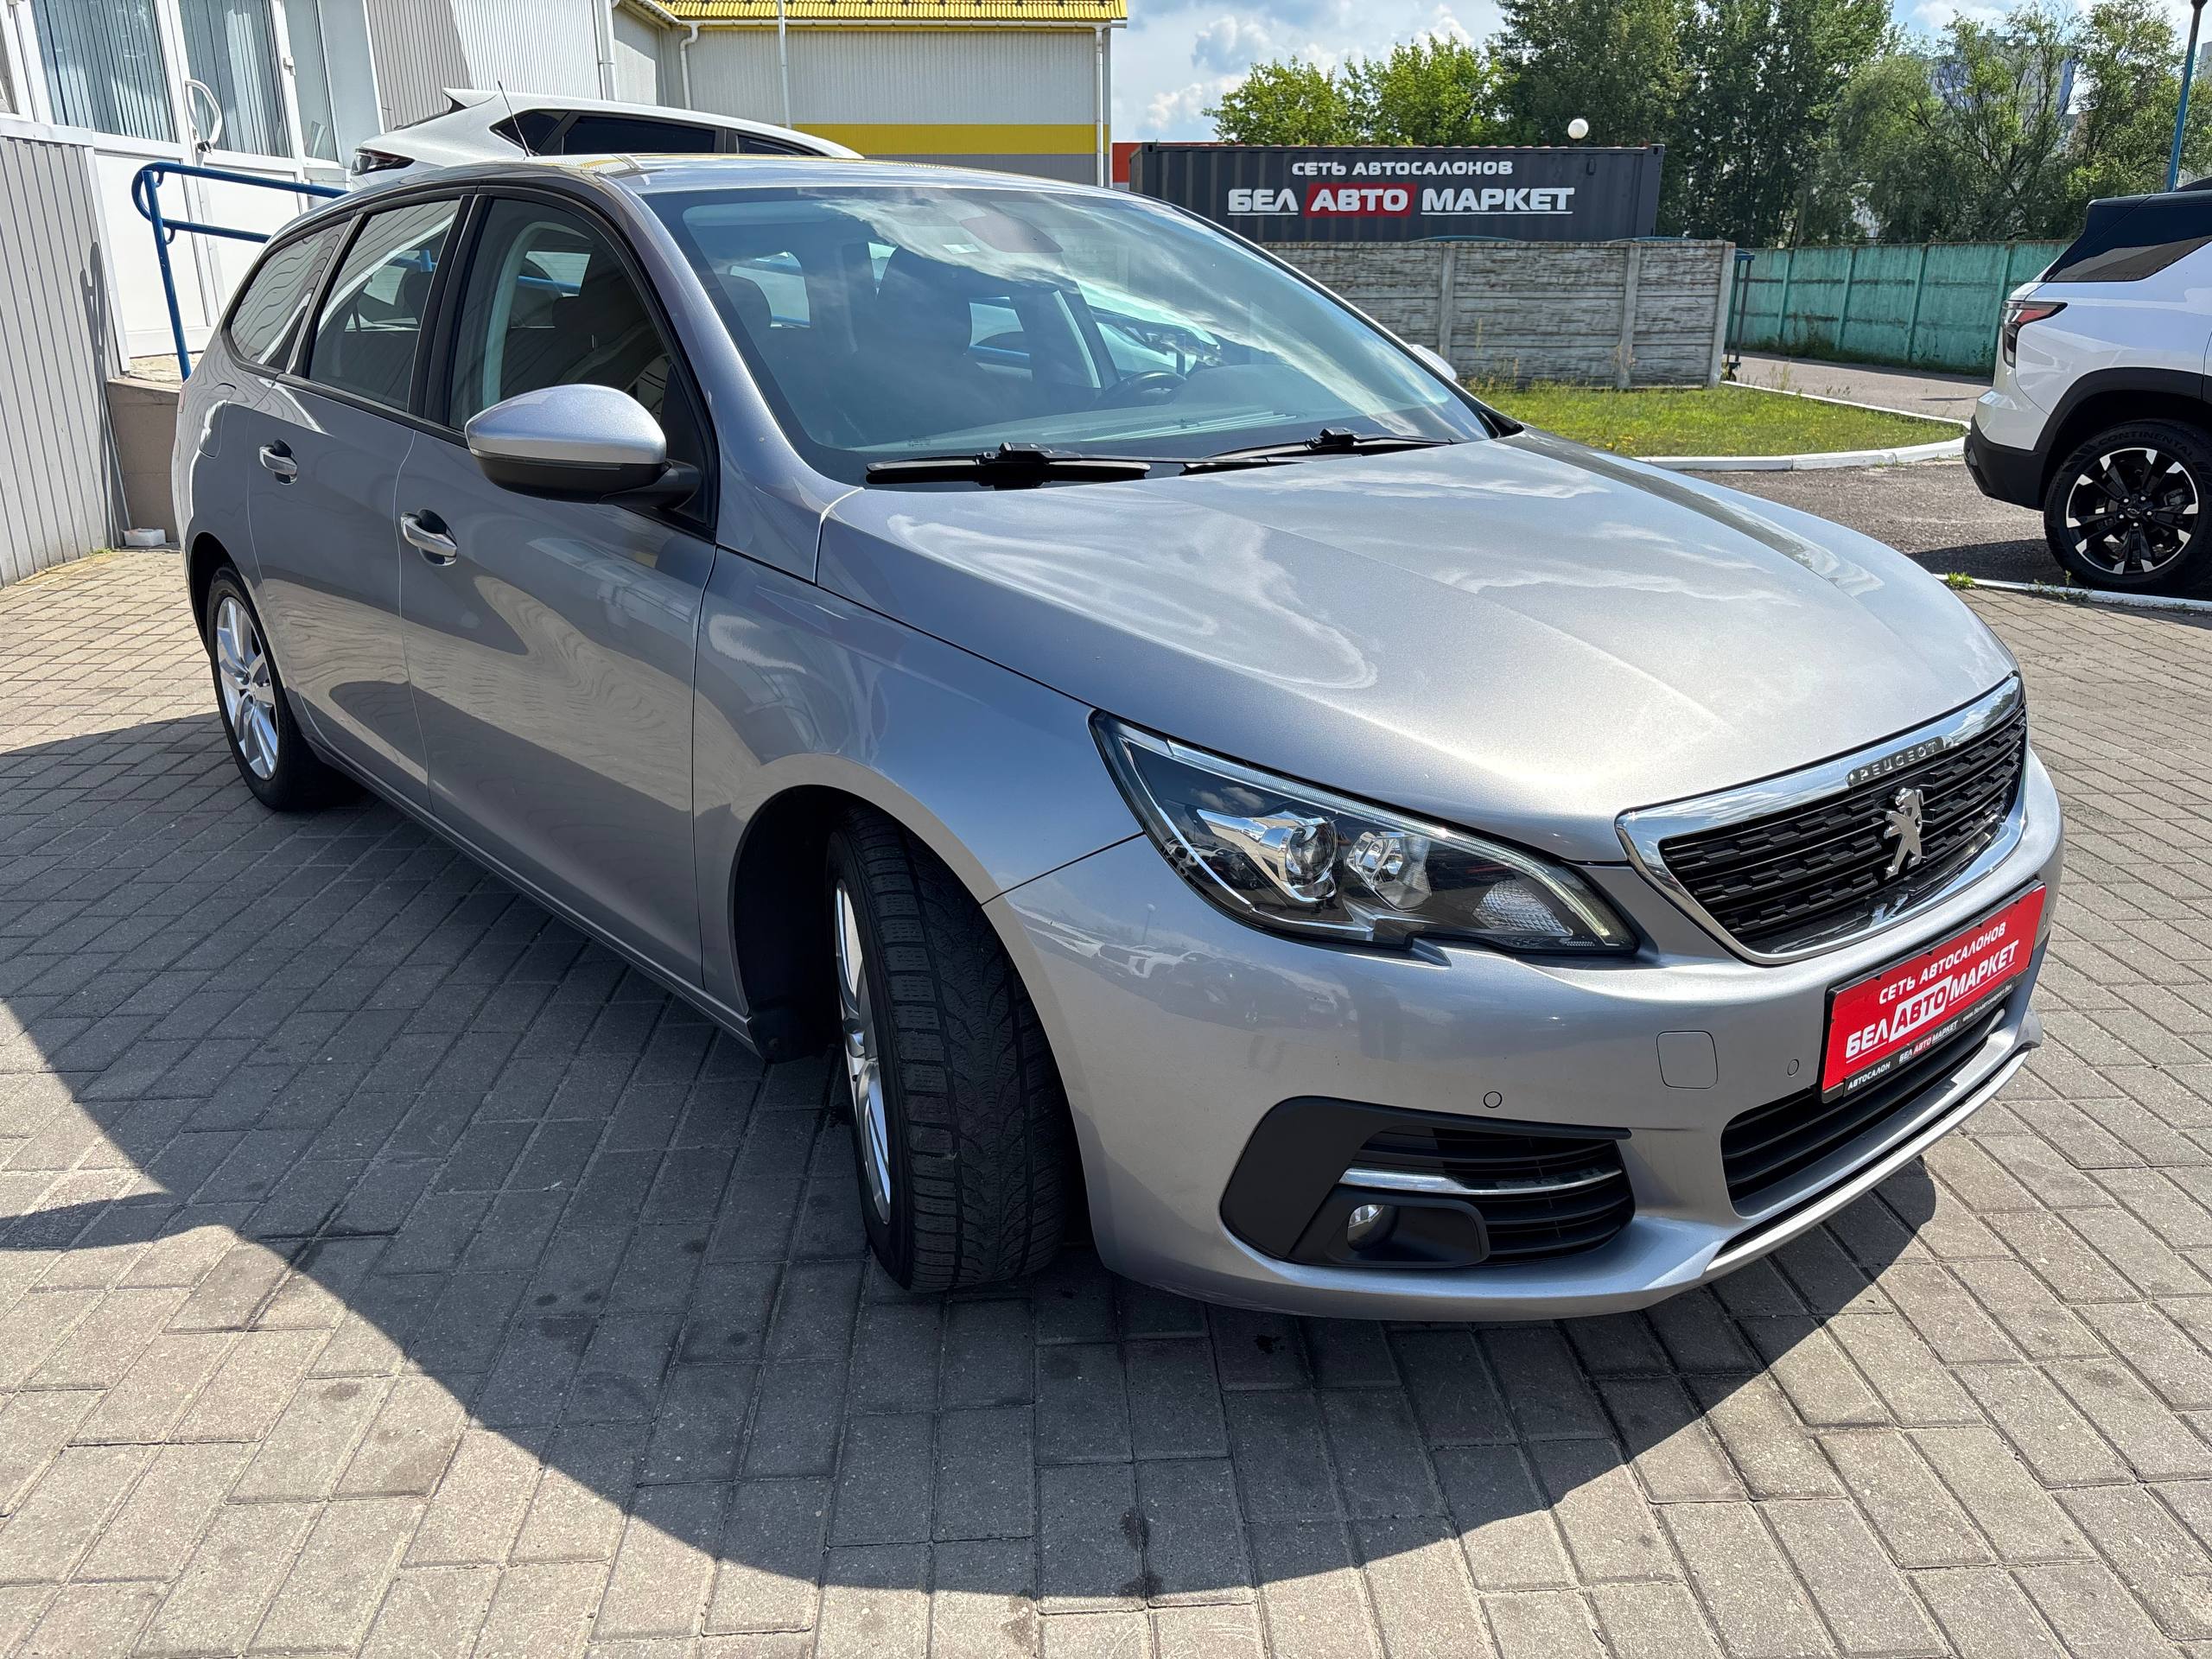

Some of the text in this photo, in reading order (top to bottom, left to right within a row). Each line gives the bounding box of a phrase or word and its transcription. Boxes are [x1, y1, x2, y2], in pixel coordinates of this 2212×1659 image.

[1292, 161, 1513, 176] СЕТЬ АВТОСАЛОНОВ
[1228, 187, 1575, 212] БЕЛ АВТО МАРКЕТ
[2098, 431, 2195, 461] CONTINENTAL
[1859, 741, 1938, 781] PEUGEOT
[1878, 921, 2006, 1004] СЕТЬ АВТОСАЛОНОВ
[1845, 939, 2019, 1058] БЕЛ АВТО МАРКЕТ
[1847, 1061, 1891, 1090] АВТОСАЛОН
[1899, 1048, 1913, 1062] БЕЛ
[1913, 1037, 1932, 1055] АВТО
[1931, 1020, 1959, 1041] МАРКЕТ
